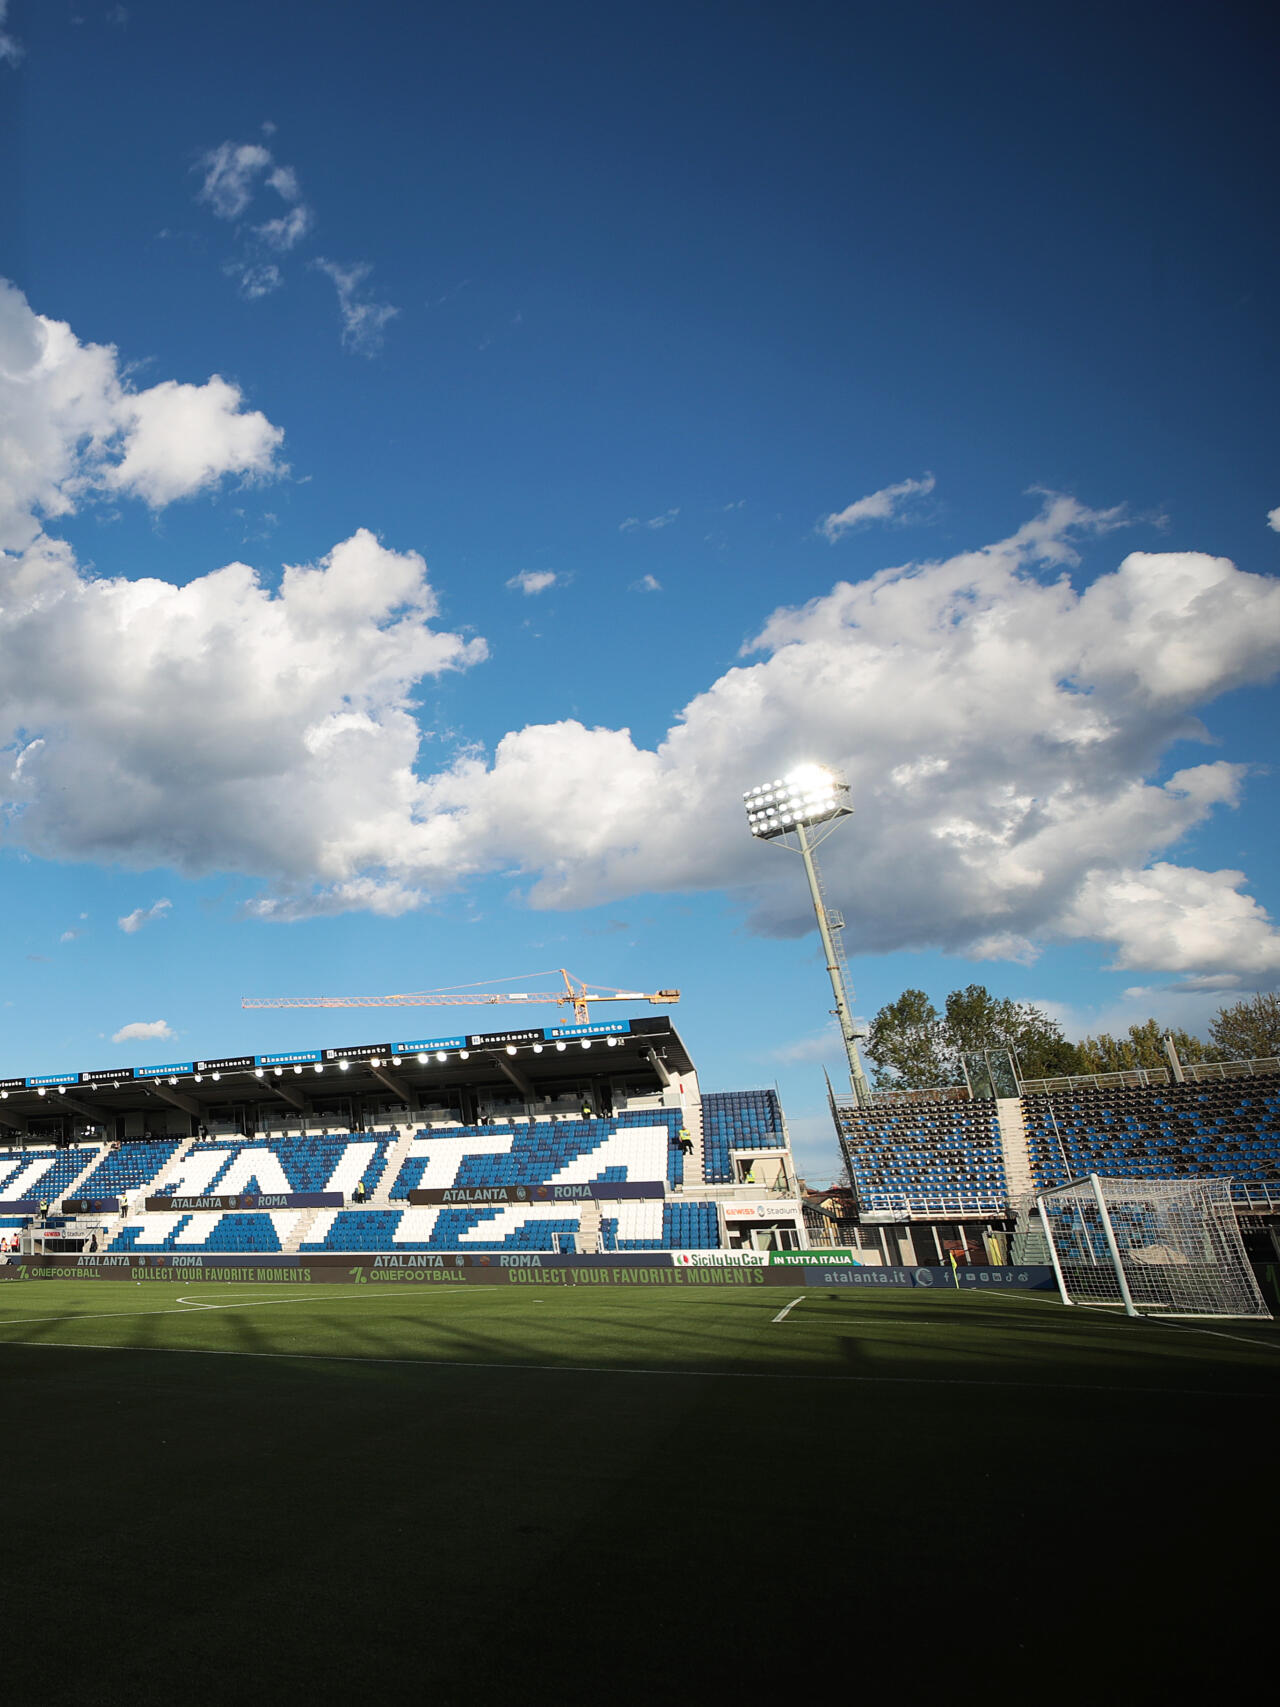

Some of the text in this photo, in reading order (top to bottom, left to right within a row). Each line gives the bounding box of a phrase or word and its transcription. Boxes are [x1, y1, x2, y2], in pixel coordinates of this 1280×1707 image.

[552, 1024, 624, 1036] Rinascimento
[472, 1032, 539, 1045] Rinascimento
[398, 1039, 461, 1051] Rinascimento
[327, 1047, 386, 1059] Rinascimento
[442, 1185, 592, 1201] ATALANTA ROMA
[170, 1195, 288, 1208] ATALANTA ROMA
[767, 1207, 798, 1215] Stadium
[77, 1257, 203, 1267] ATALANTA ROMA
[374, 1255, 542, 1267] ATALANTA ROMA
[691, 1254, 723, 1266] Sicily
[741, 1253, 764, 1266] Car
[773, 1256, 852, 1264] IN TUTTA ITALIA
[32, 1268, 101, 1278] ONEFOOTBALL
[132, 1267, 311, 1281] COLLECT YOUR FAVORITE MOMENTS
[370, 1269, 466, 1281] ONEFOOTBALL
[509, 1268, 764, 1284] COLLECT YOUR FAVORITE MOMENTS
[824, 1270, 906, 1284] atalanta.it
